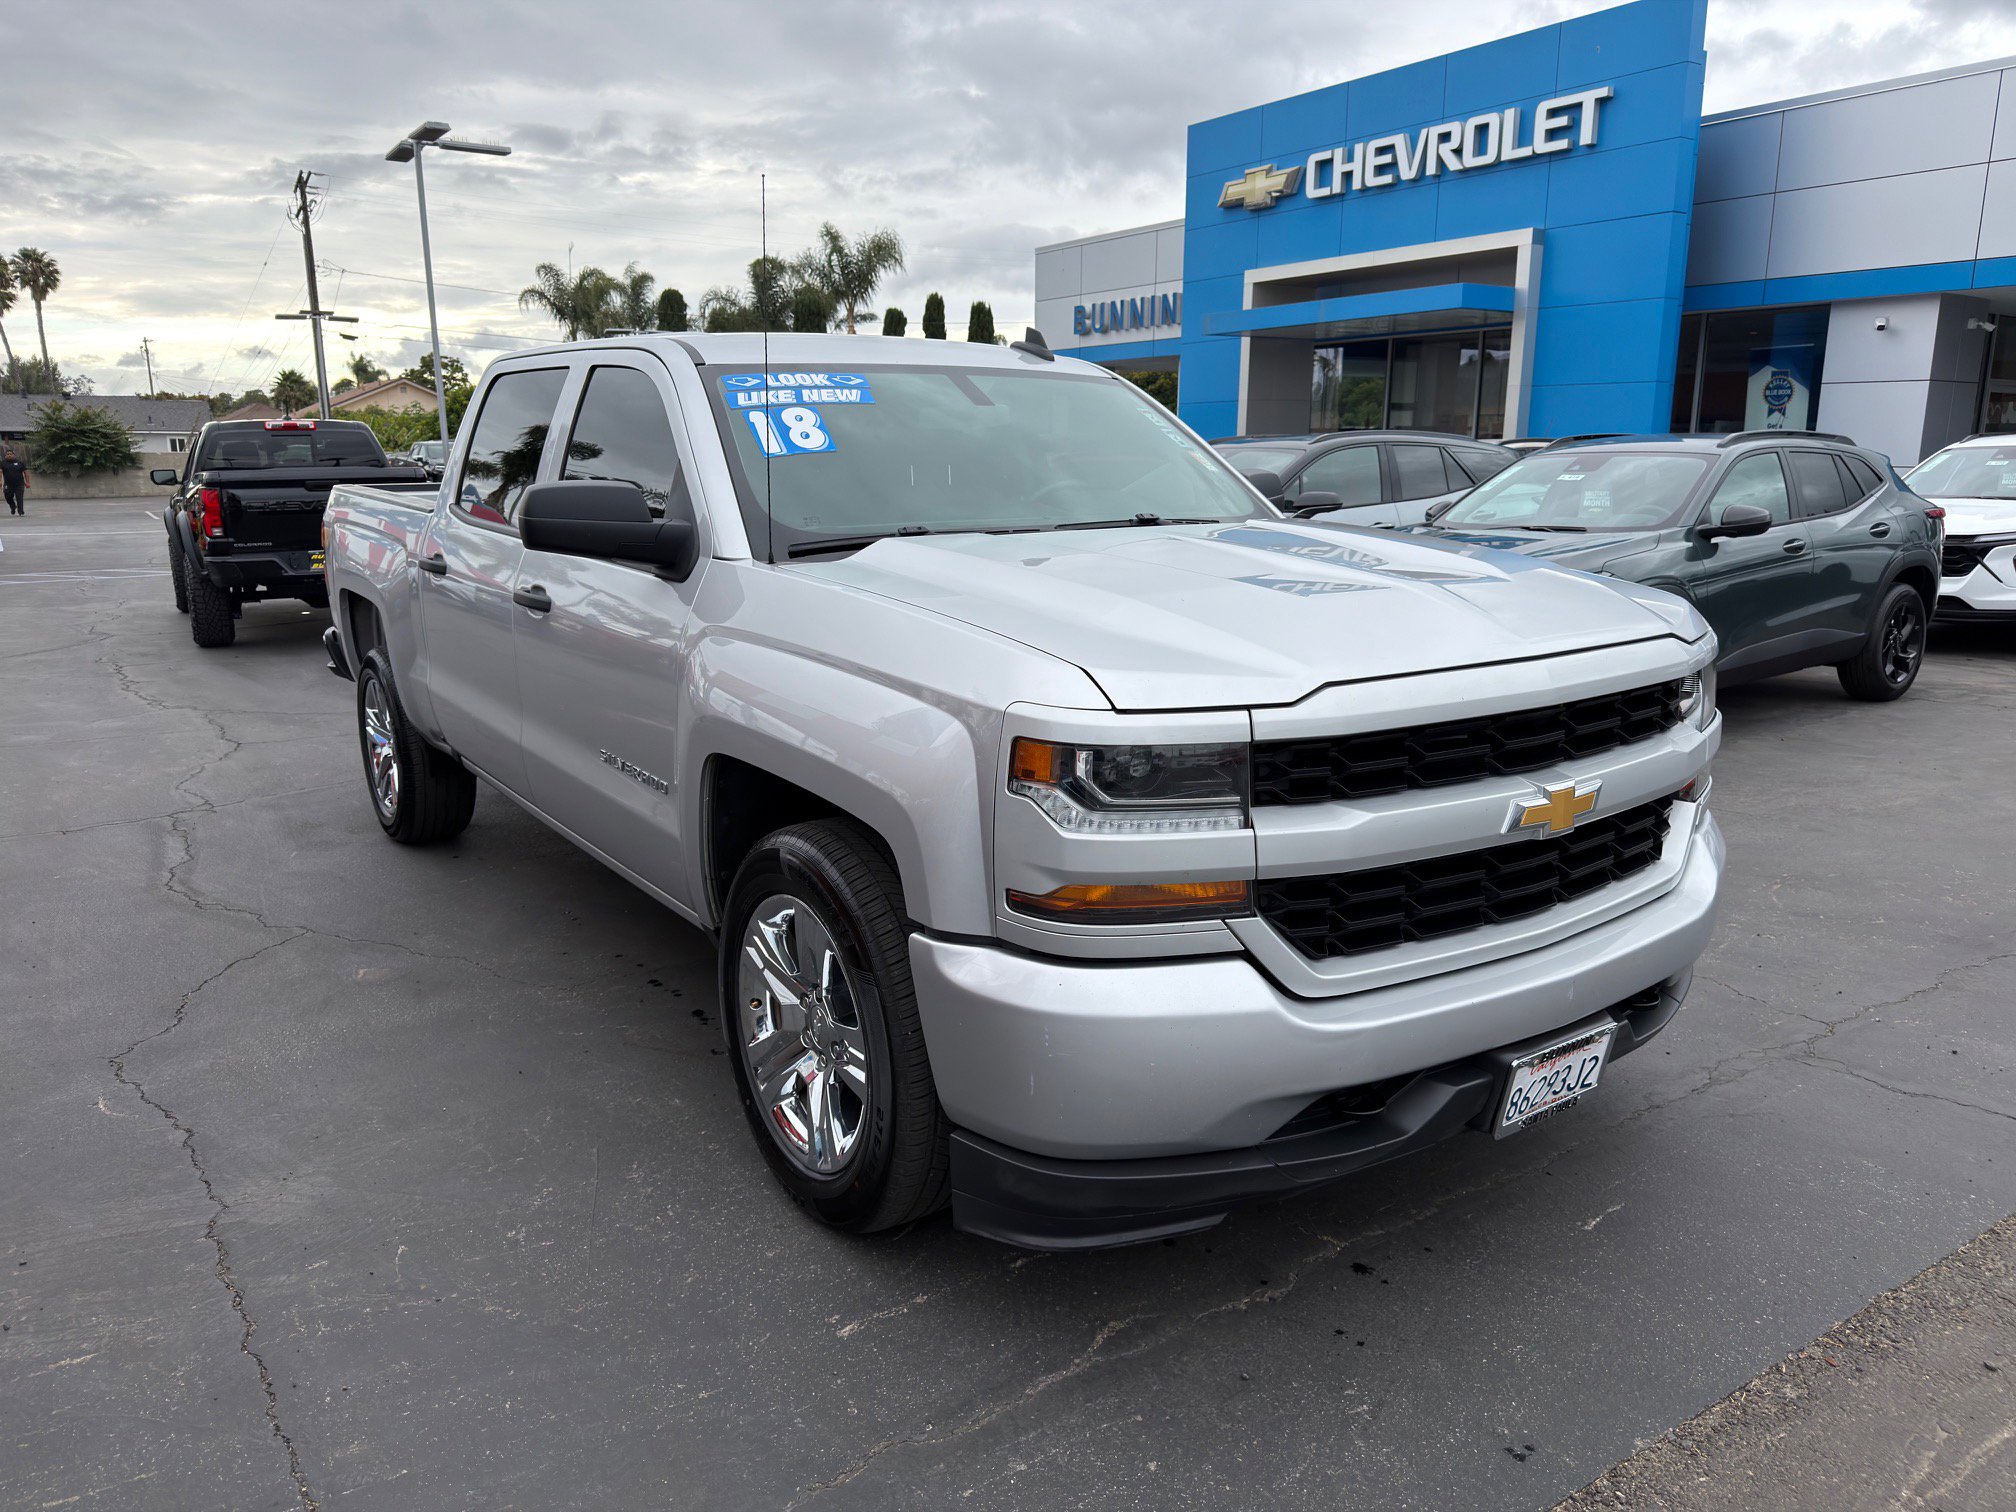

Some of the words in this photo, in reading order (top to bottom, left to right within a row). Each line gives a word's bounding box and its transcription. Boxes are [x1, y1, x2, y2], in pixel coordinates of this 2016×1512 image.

[1305, 86, 1614, 200] CHEVROLET
[1073, 292, 1182, 336] BUNNIN
[737, 390, 797, 406] LIKE
[802, 389, 862, 403] NEW
[764, 373, 835, 387] LOOK
[748, 407, 830, 454] 18
[599, 749, 668, 795] SILVERADO
[1540, 1033, 1596, 1063] BUNNIN
[1505, 1054, 1600, 1121] 86293J2
[1520, 1109, 1548, 1130] SANTA
[1551, 1097, 1578, 1117] PAULA
